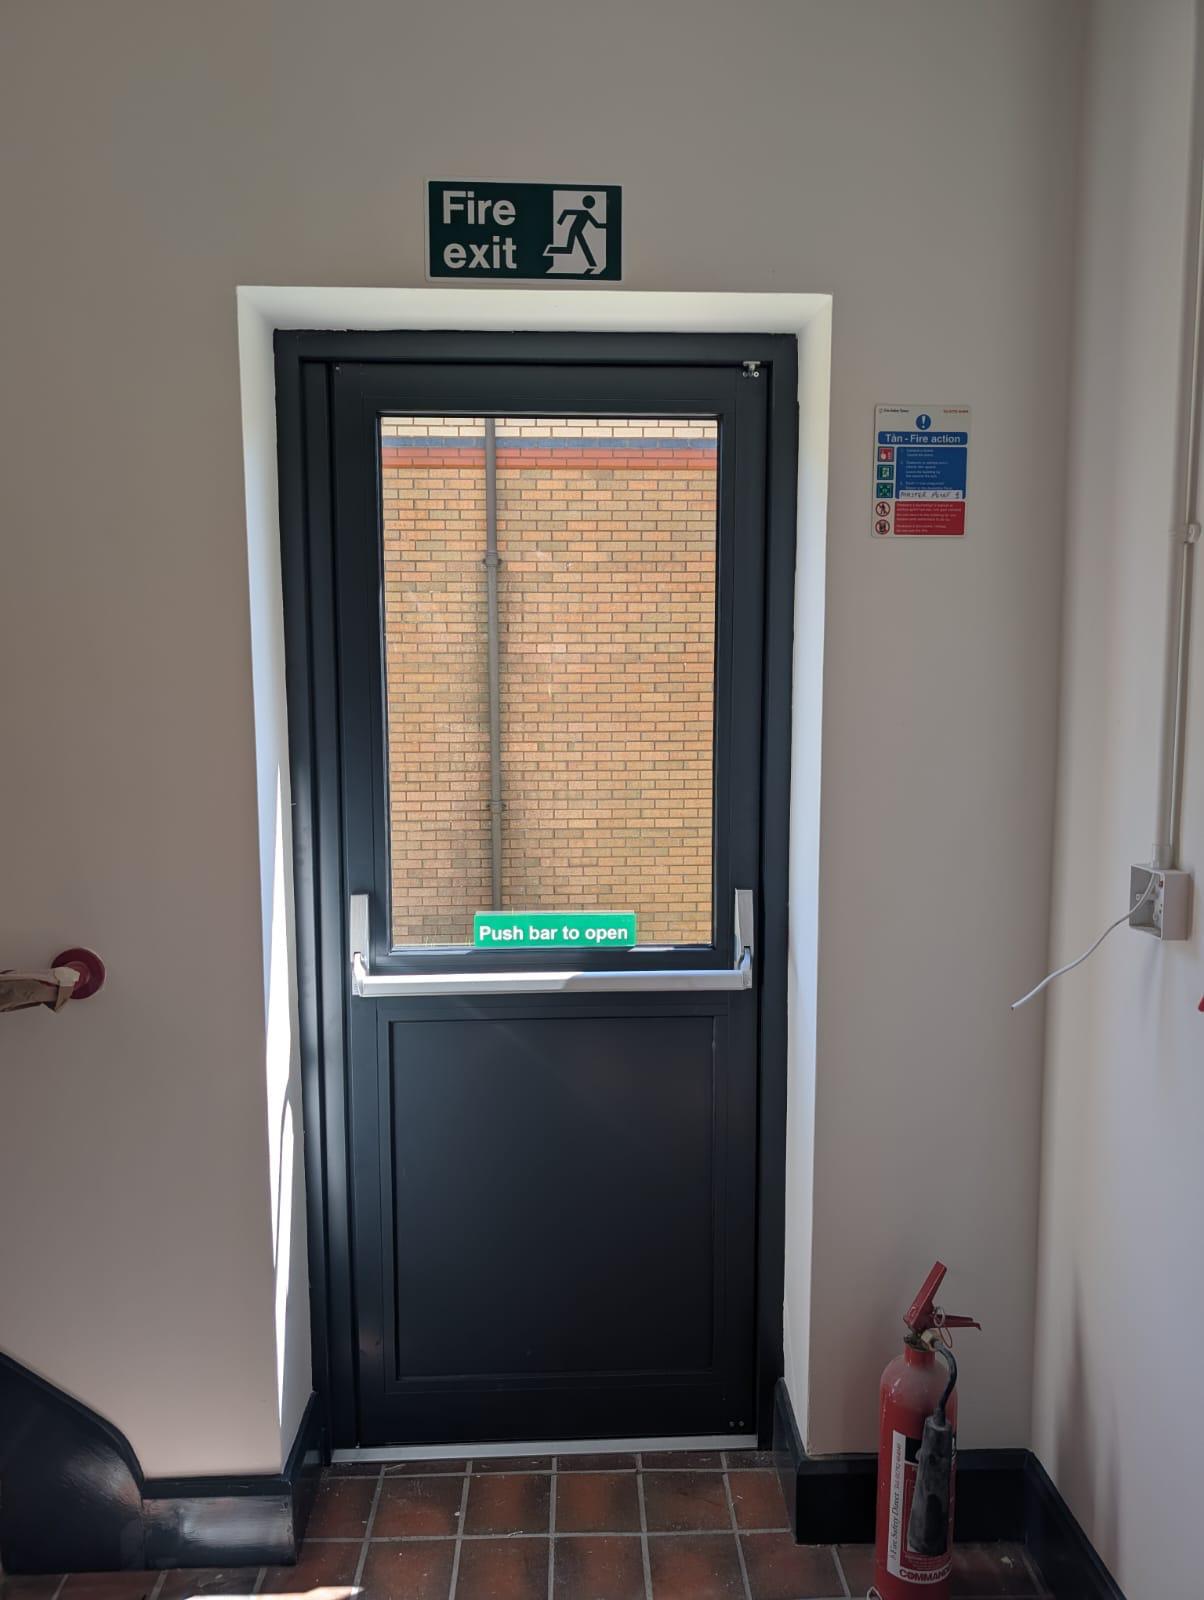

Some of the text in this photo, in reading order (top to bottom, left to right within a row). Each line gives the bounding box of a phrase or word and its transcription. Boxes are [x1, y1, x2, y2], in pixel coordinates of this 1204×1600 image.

[443, 190, 516, 226] Fire
[443, 235, 517, 269] exit
[910, 434, 929, 443] Fire
[931, 434, 961, 443] action
[479, 925, 628, 943] Push bar to open
[892, 1492, 900, 1516] Direct
[891, 1517, 900, 1539] Safety
